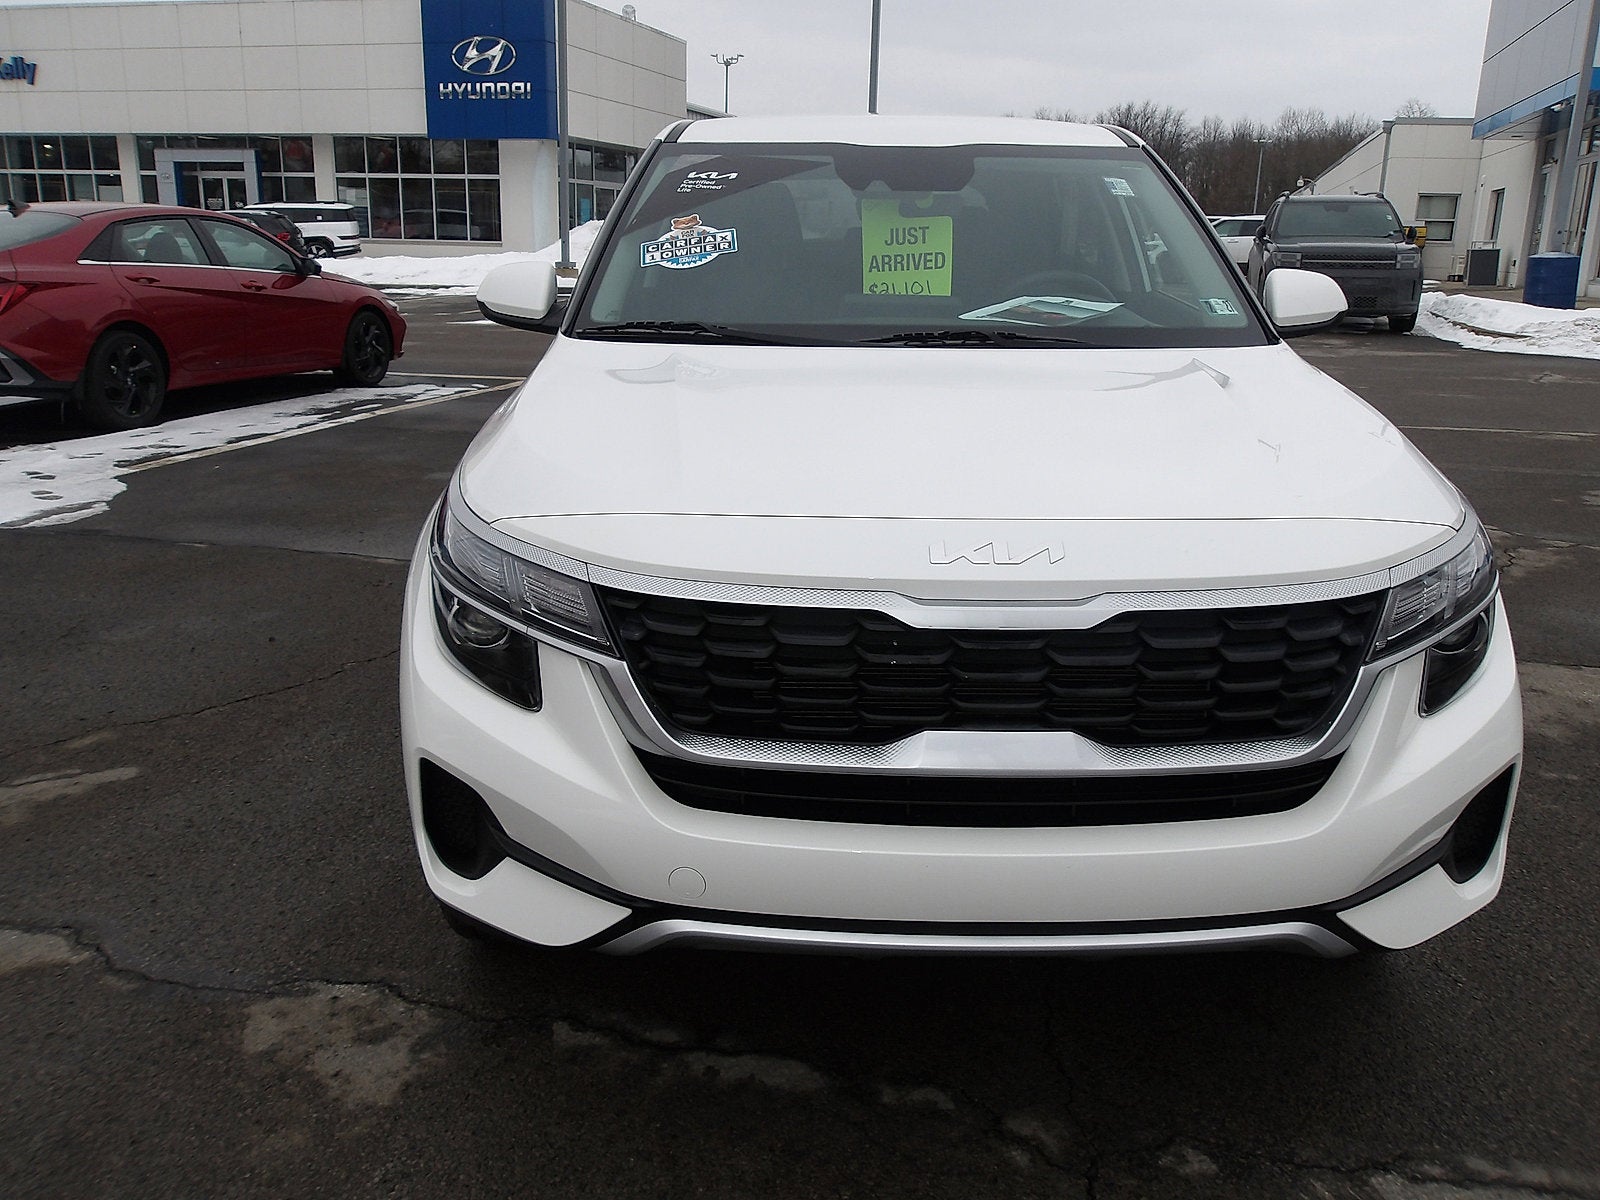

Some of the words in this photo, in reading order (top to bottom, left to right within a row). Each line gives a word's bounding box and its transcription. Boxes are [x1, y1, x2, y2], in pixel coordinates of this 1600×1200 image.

[439, 82, 532, 99] HYUNDAI
[648, 234, 729, 252] CARFAX
[884, 226, 930, 246] JUST
[661, 242, 730, 259] OWNER
[868, 251, 946, 273] ARRIVED
